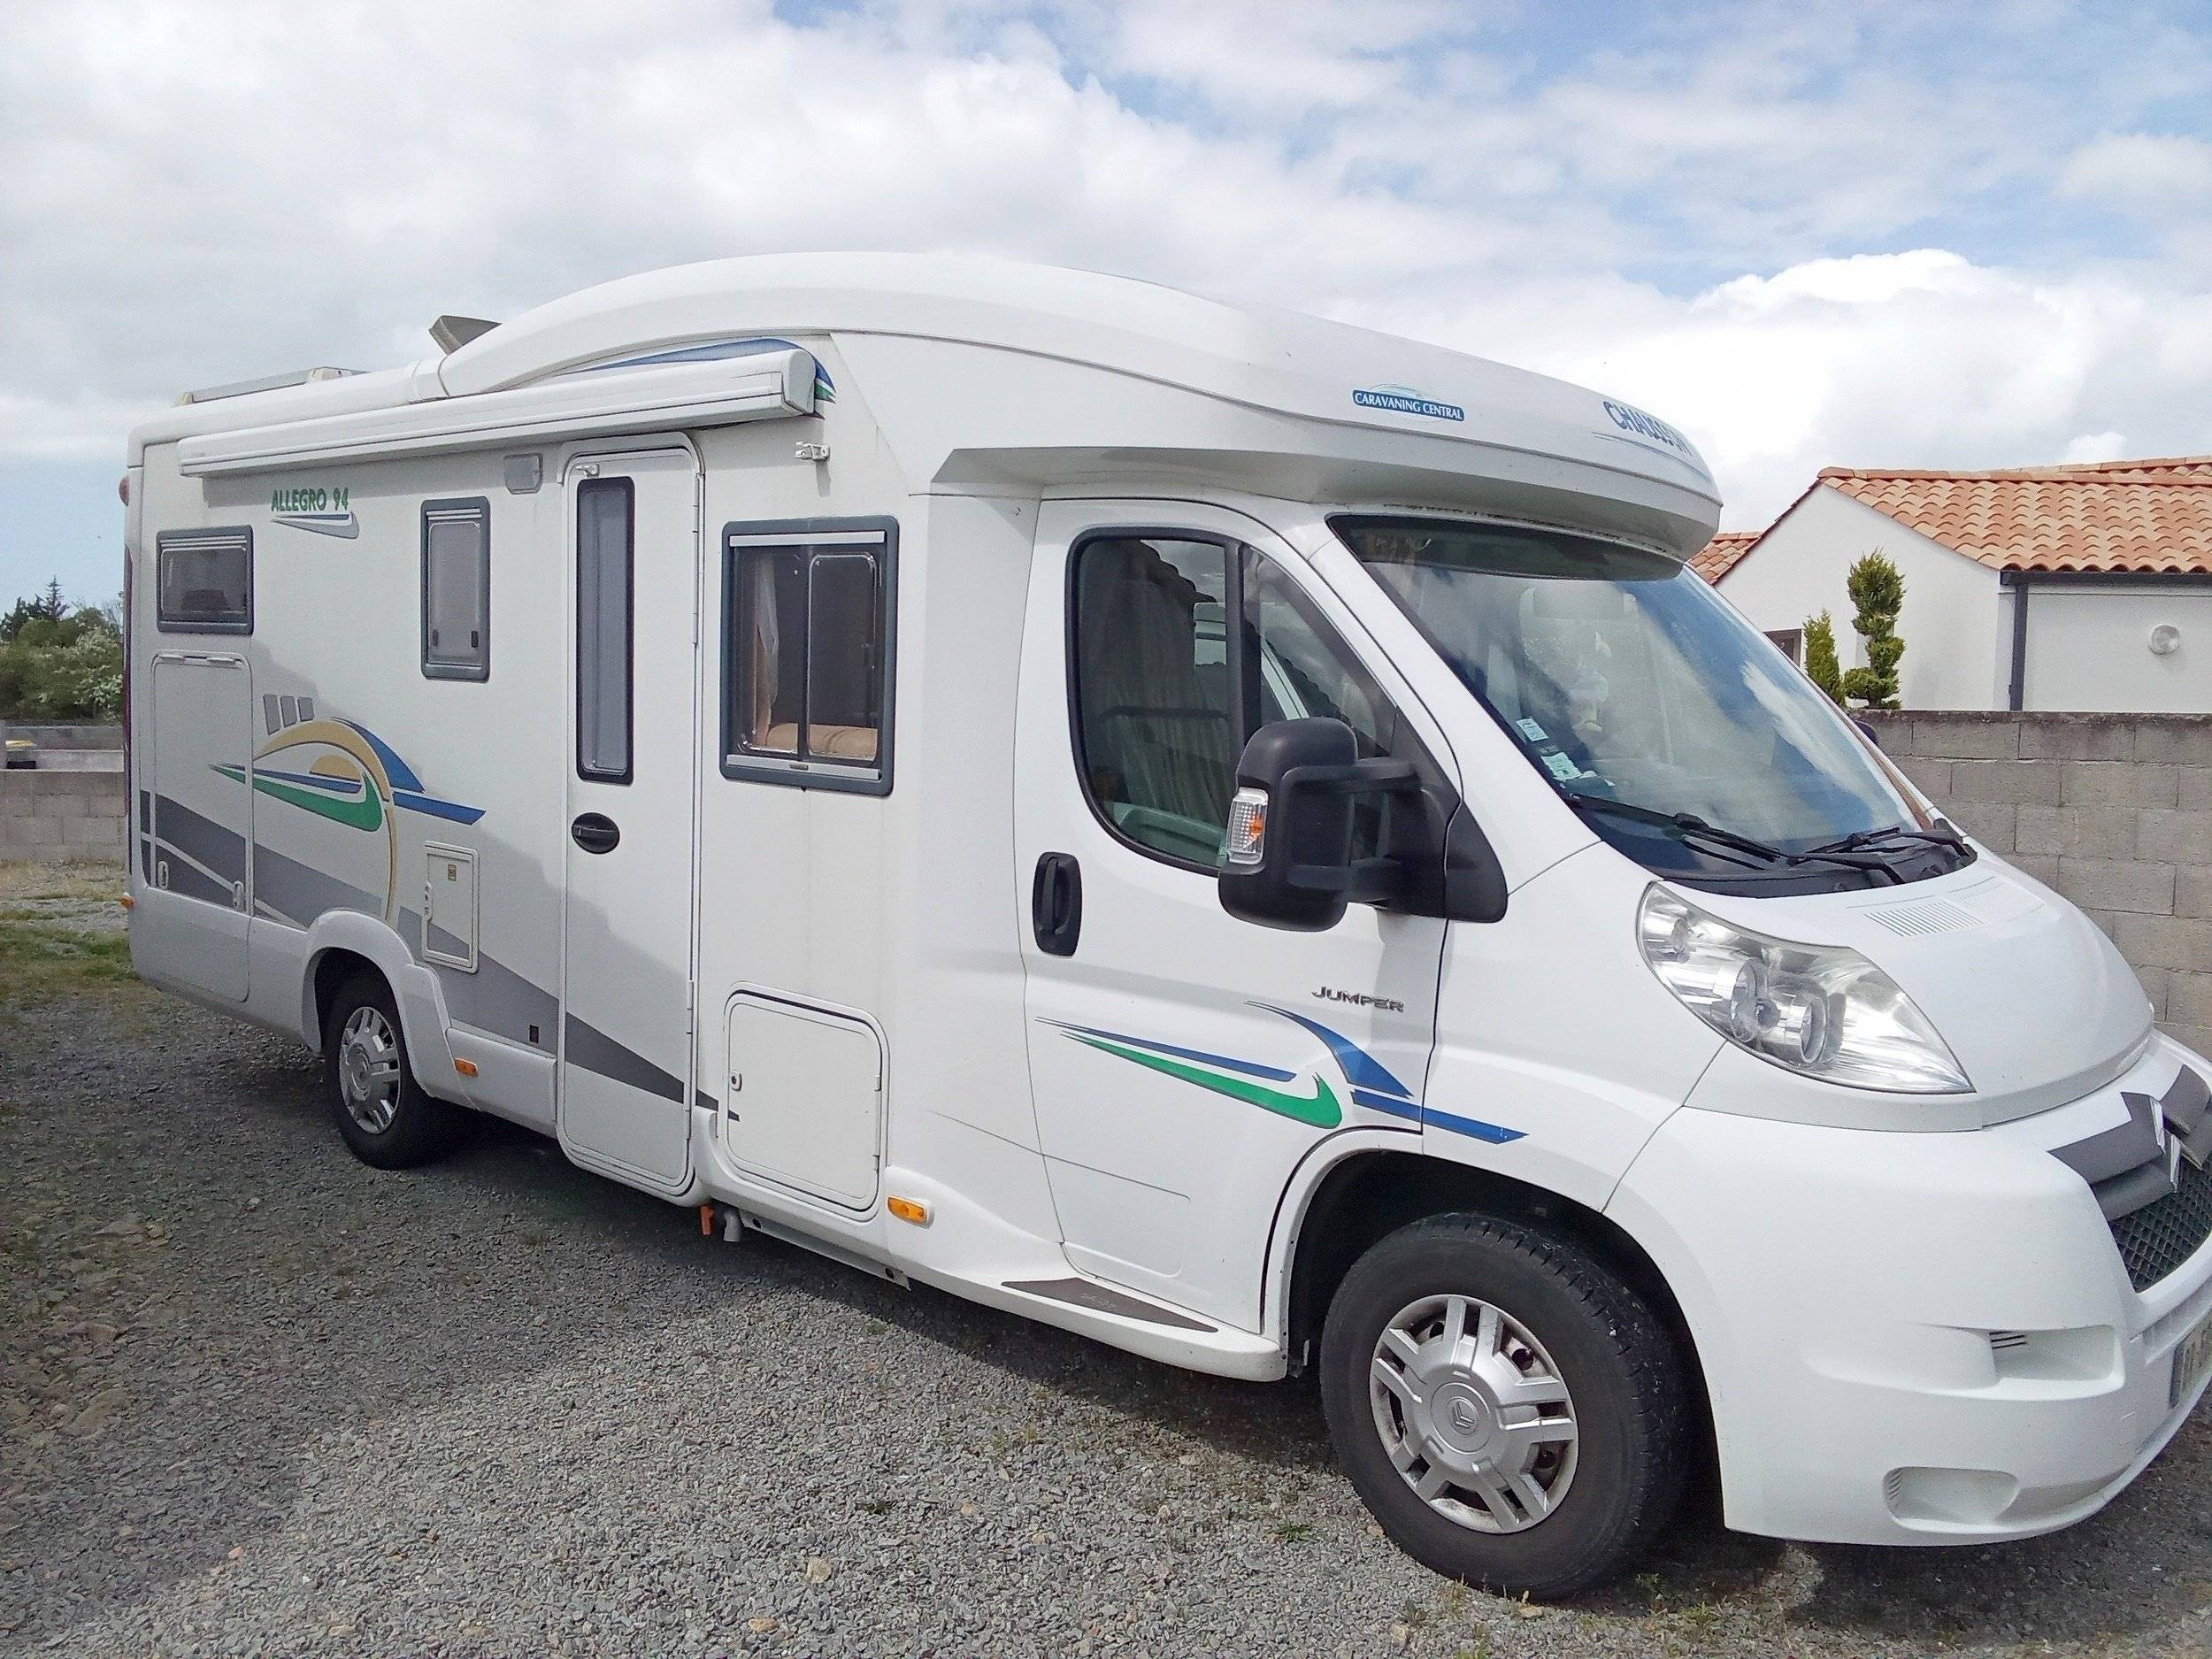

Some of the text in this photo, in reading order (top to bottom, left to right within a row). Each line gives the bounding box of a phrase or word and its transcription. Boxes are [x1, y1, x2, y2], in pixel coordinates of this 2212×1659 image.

[1354, 392, 1463, 420] CARAVANING CENTRAL
[271, 487, 349, 511] ALLEGRO 94
[1310, 986, 1404, 1013] JUMPER
